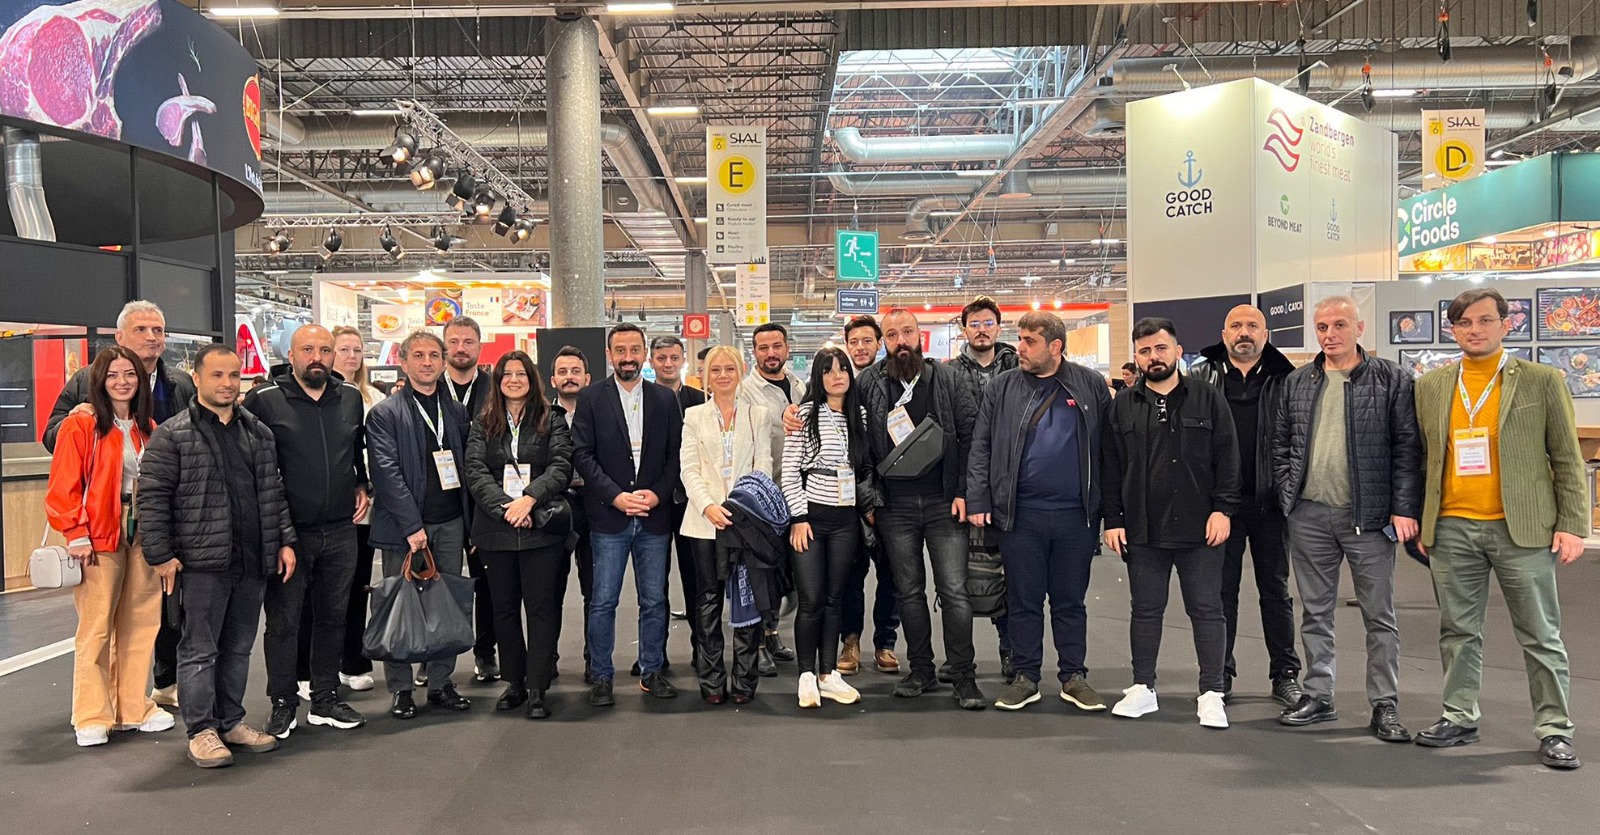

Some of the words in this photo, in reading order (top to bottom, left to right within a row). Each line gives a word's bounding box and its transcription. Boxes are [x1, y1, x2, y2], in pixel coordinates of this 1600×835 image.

[1447, 116, 1480, 128] SIAL
[730, 132, 762, 144] SIAL
[1309, 116, 1354, 147] Zandbergen
[1432, 126, 1439, 135] 6
[716, 141, 723, 150] 6
[1310, 139, 1336, 159] world's
[1446, 146, 1467, 171] D
[729, 161, 744, 188] E
[1310, 154, 1331, 176] finest
[1332, 165, 1351, 182] meat
[1165, 188, 1212, 204] GOOD
[1165, 201, 1213, 218] CATCH
[1411, 192, 1457, 225] Circle
[1267, 216, 1289, 230] BEYOND
[1289, 222, 1303, 233] MEAT
[1326, 222, 1340, 233] GOOD
[1411, 216, 1460, 249] Foods
[1326, 232, 1341, 241] CATCH
[465, 309, 490, 317] France
[1269, 305, 1284, 316] GOOD
[1288, 301, 1303, 312] CATCH
